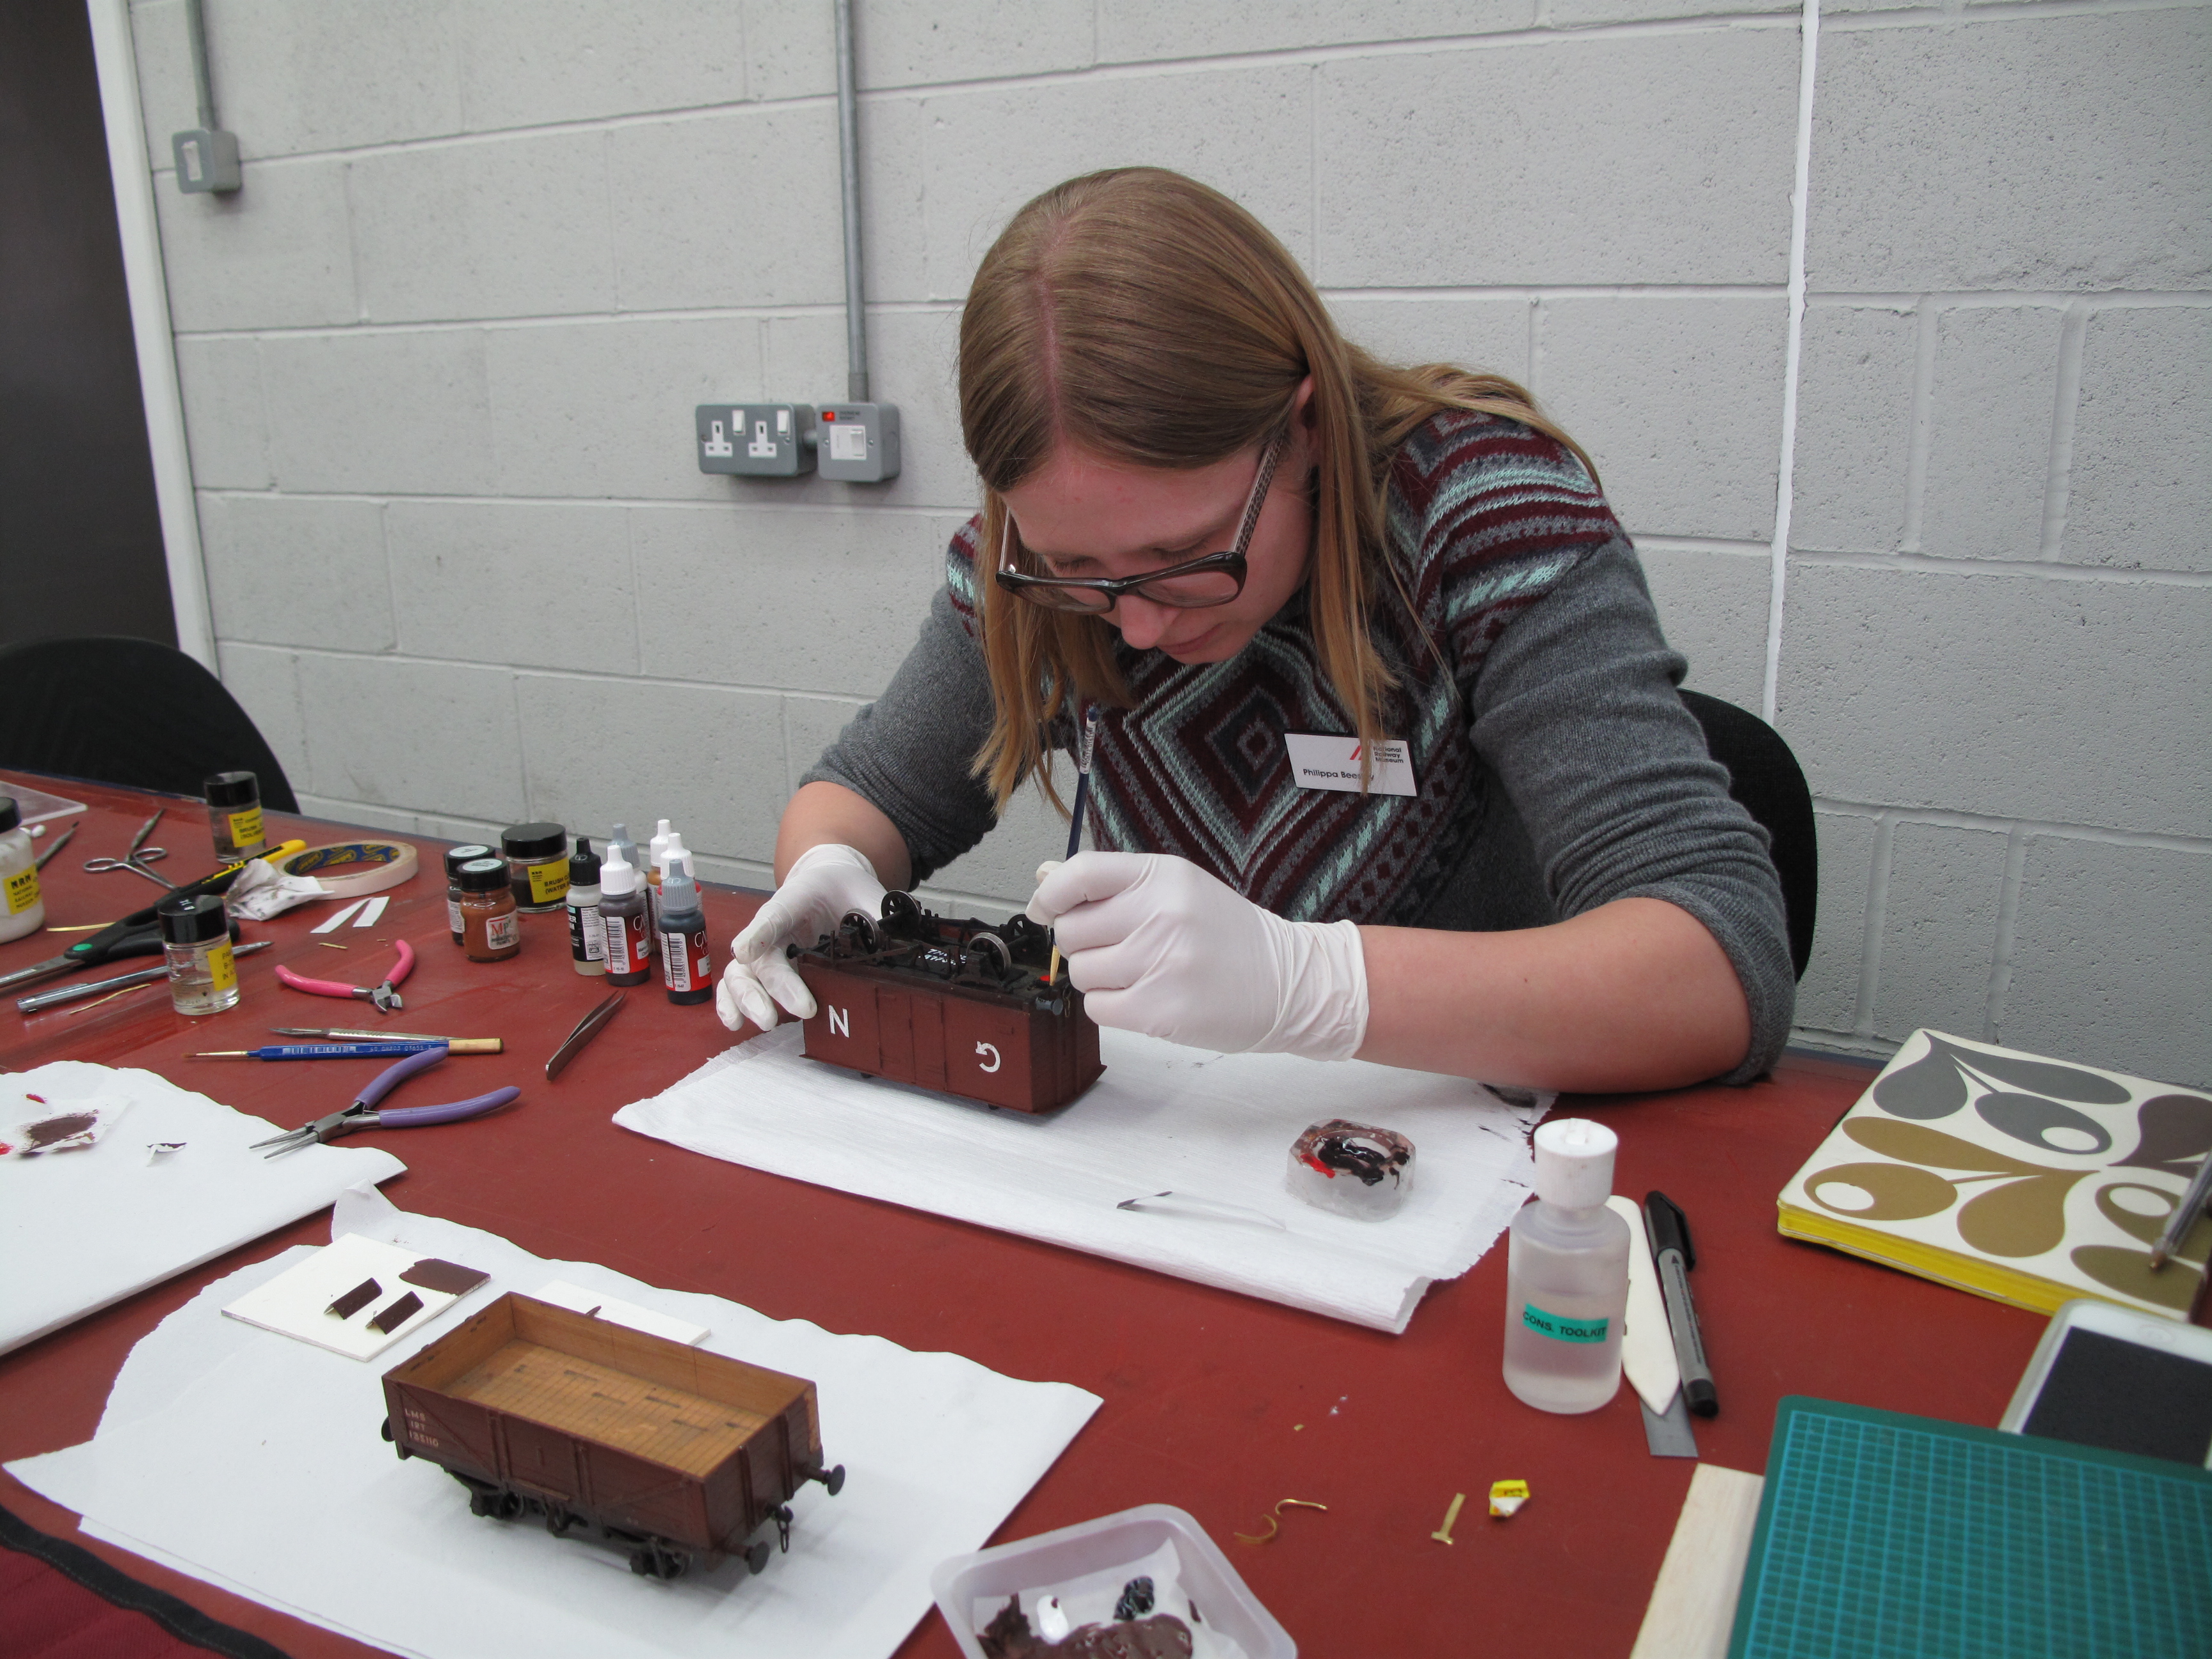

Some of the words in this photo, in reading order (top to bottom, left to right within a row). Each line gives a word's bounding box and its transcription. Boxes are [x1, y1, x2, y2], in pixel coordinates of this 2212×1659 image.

[1303, 769, 1338, 778] Philippa
[1341, 771, 1374, 781] Beesy
[544, 877, 563, 887] BRUSH
[828, 1004, 849, 1038] N
[1559, 1326, 1607, 1337] TOOLKIT
